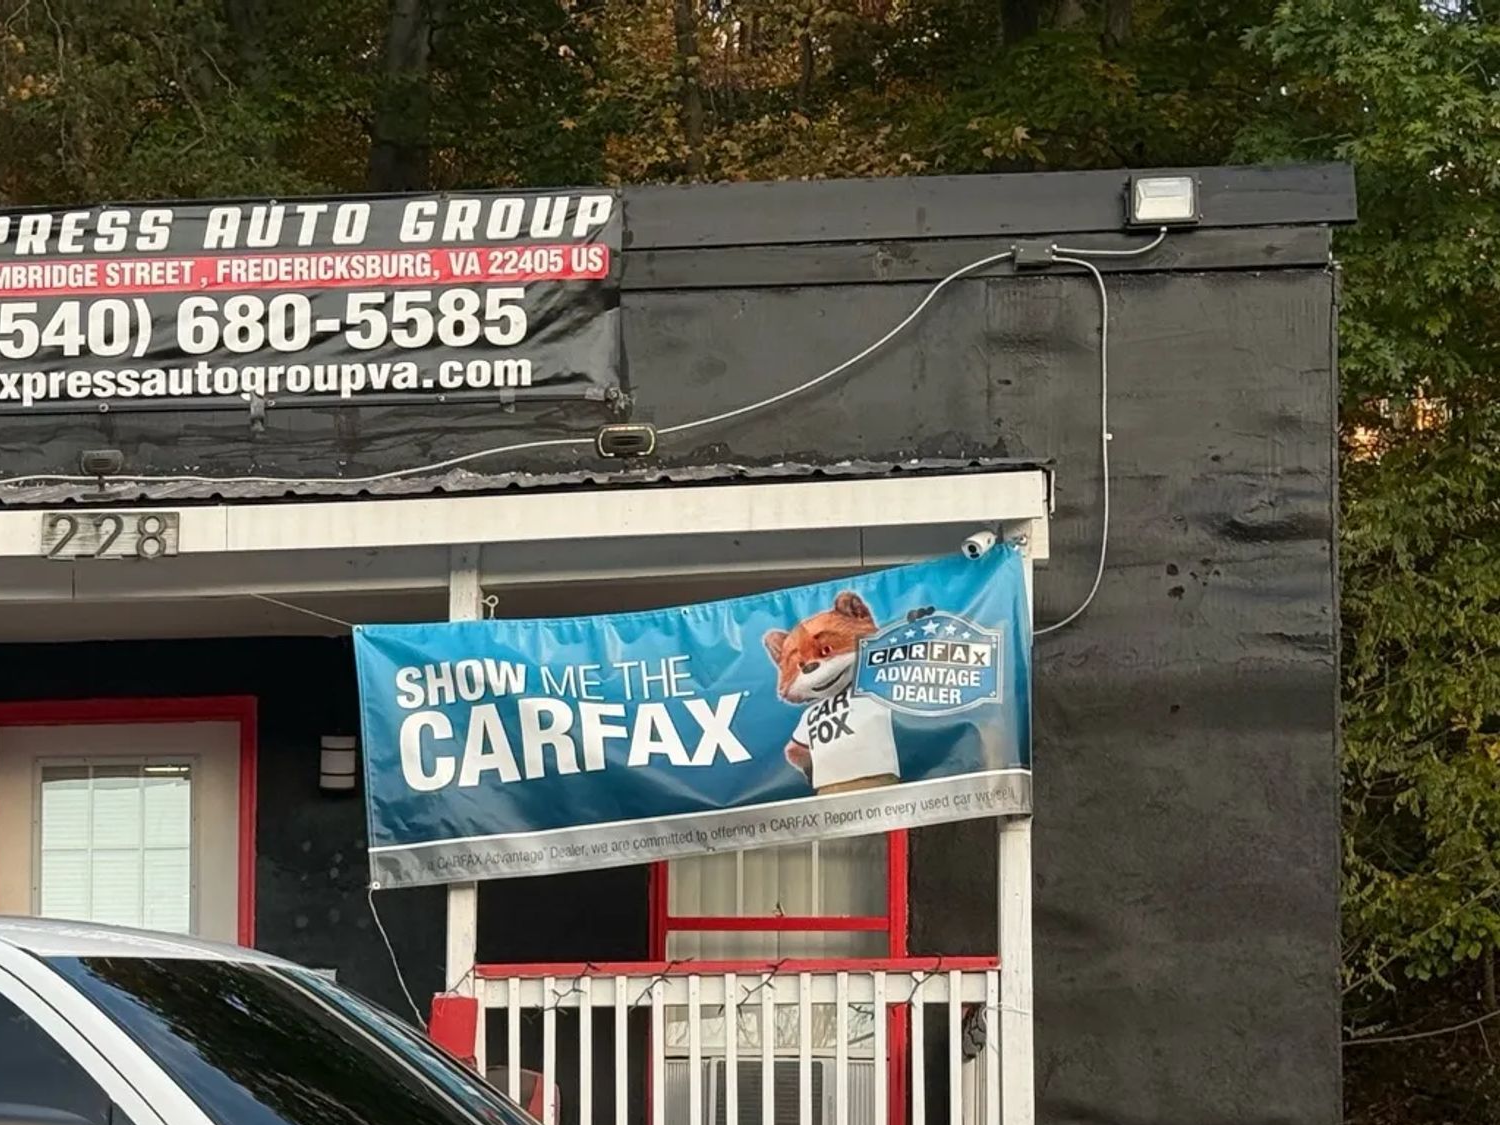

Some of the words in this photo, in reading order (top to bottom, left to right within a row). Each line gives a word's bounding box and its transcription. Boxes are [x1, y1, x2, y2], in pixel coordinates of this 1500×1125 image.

[203, 203, 371, 250] AUTO
[399, 195, 614, 243] GROUP
[216, 252, 441, 283] FREDERICKSBURG,
[449, 252, 481, 276] VA
[488, 250, 563, 276] 22405
[572, 248, 603, 272] US
[175, 286, 529, 355] 680-5585
[48, 512, 168, 561] 228
[867, 640, 991, 666] CARFAX
[396, 658, 526, 709] SHOW
[541, 663, 605, 699] ME
[614, 655, 696, 700] THE
[874, 666, 982, 688] ADVANTAGE
[892, 684, 962, 705] DEALER
[807, 691, 851, 727] CAR
[808, 710, 855, 750] FOX
[399, 691, 753, 792] CARFAX
[436, 854, 483, 872] CARFAX
[591, 841, 608, 856] we
[610, 840, 630, 852] are
[632, 830, 693, 850] committed
[695, 830, 708, 843] to
[710, 822, 757, 842] offering
[758, 823, 767, 835] a
[769, 812, 818, 833] CARFAX
[823, 808, 863, 829] Report
[865, 804, 882, 820] on
[884, 800, 917, 817] every
[920, 795, 950, 811] used
[953, 791, 973, 806] car
